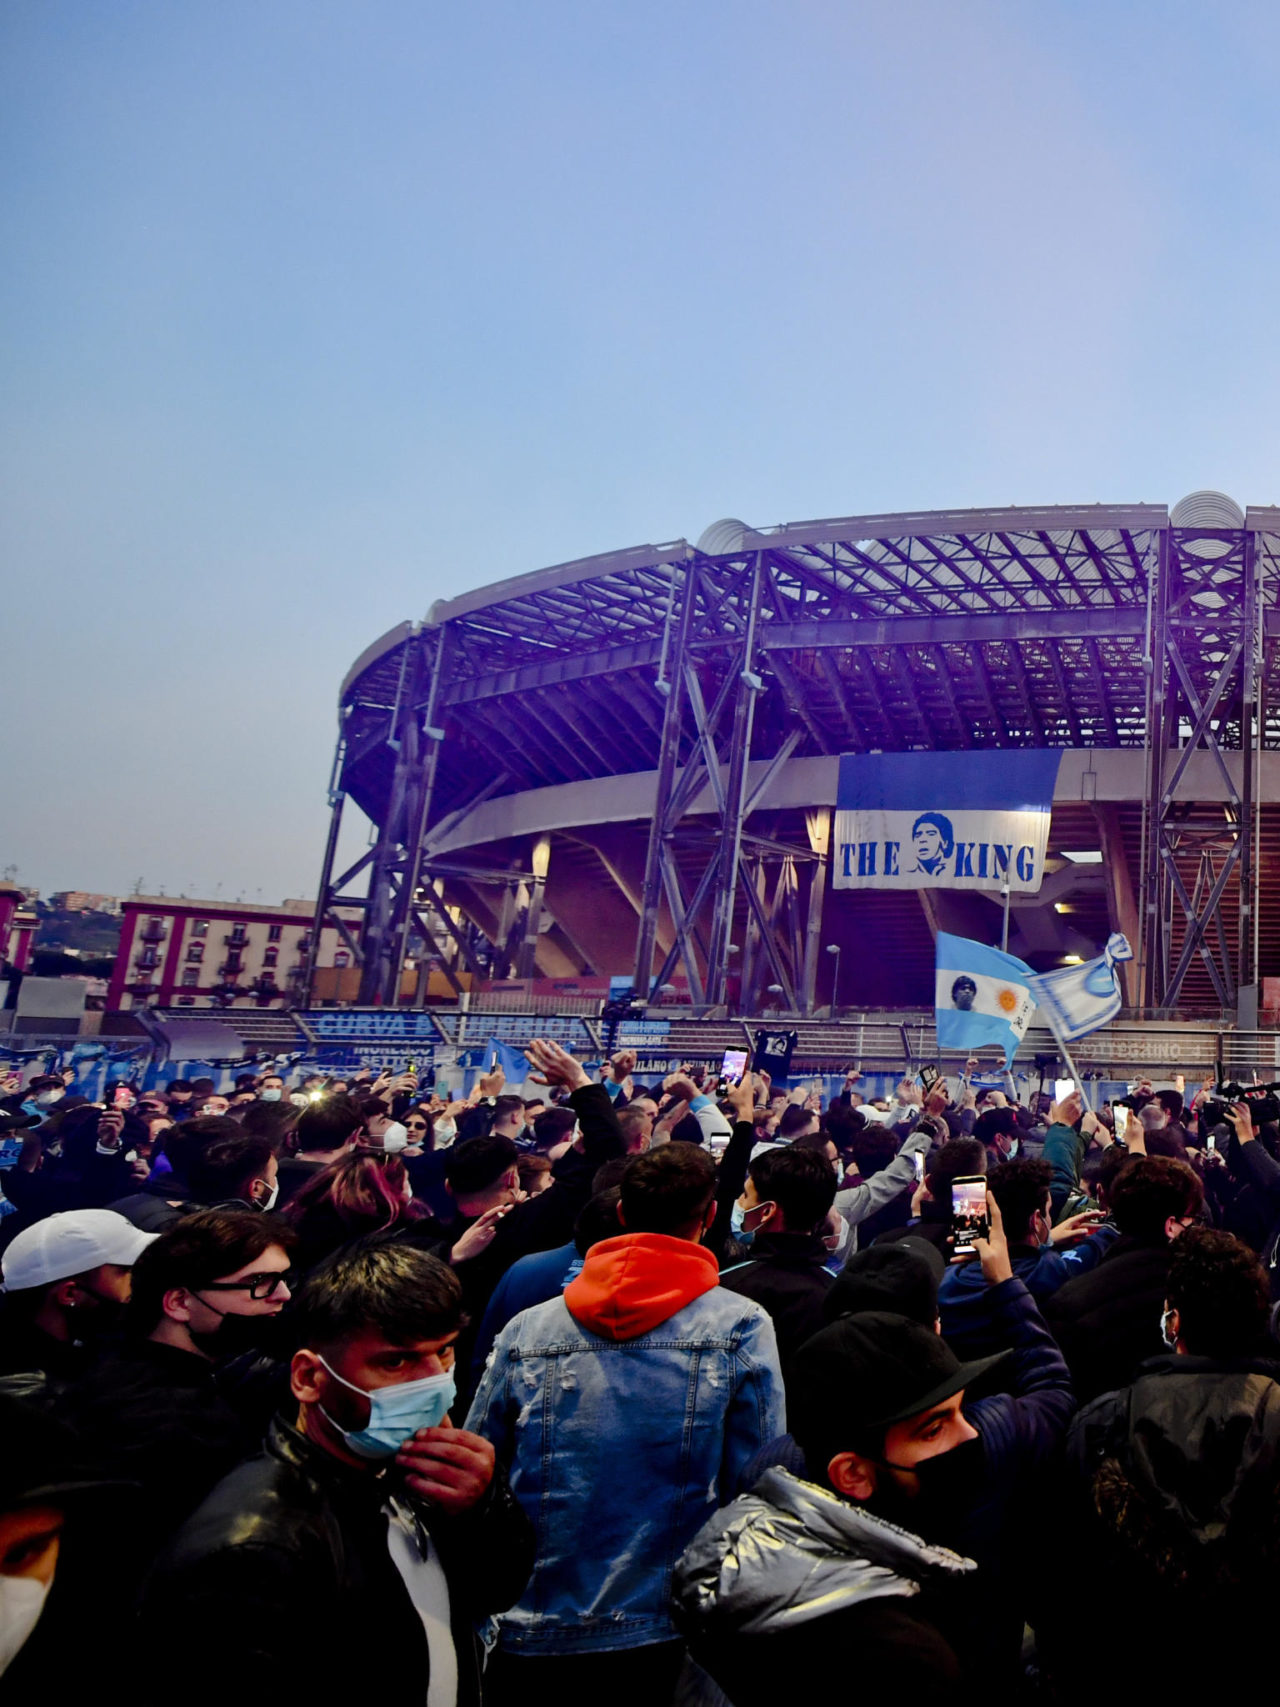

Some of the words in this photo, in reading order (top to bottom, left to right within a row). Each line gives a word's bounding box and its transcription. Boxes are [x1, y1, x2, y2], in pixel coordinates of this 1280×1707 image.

[840, 841, 900, 877] THE
[954, 842, 1035, 883] KING
[318, 1014, 406, 1035] CURVA
[415, 1014, 433, 1035] B
[360, 1056, 434, 1067] SETTORE
